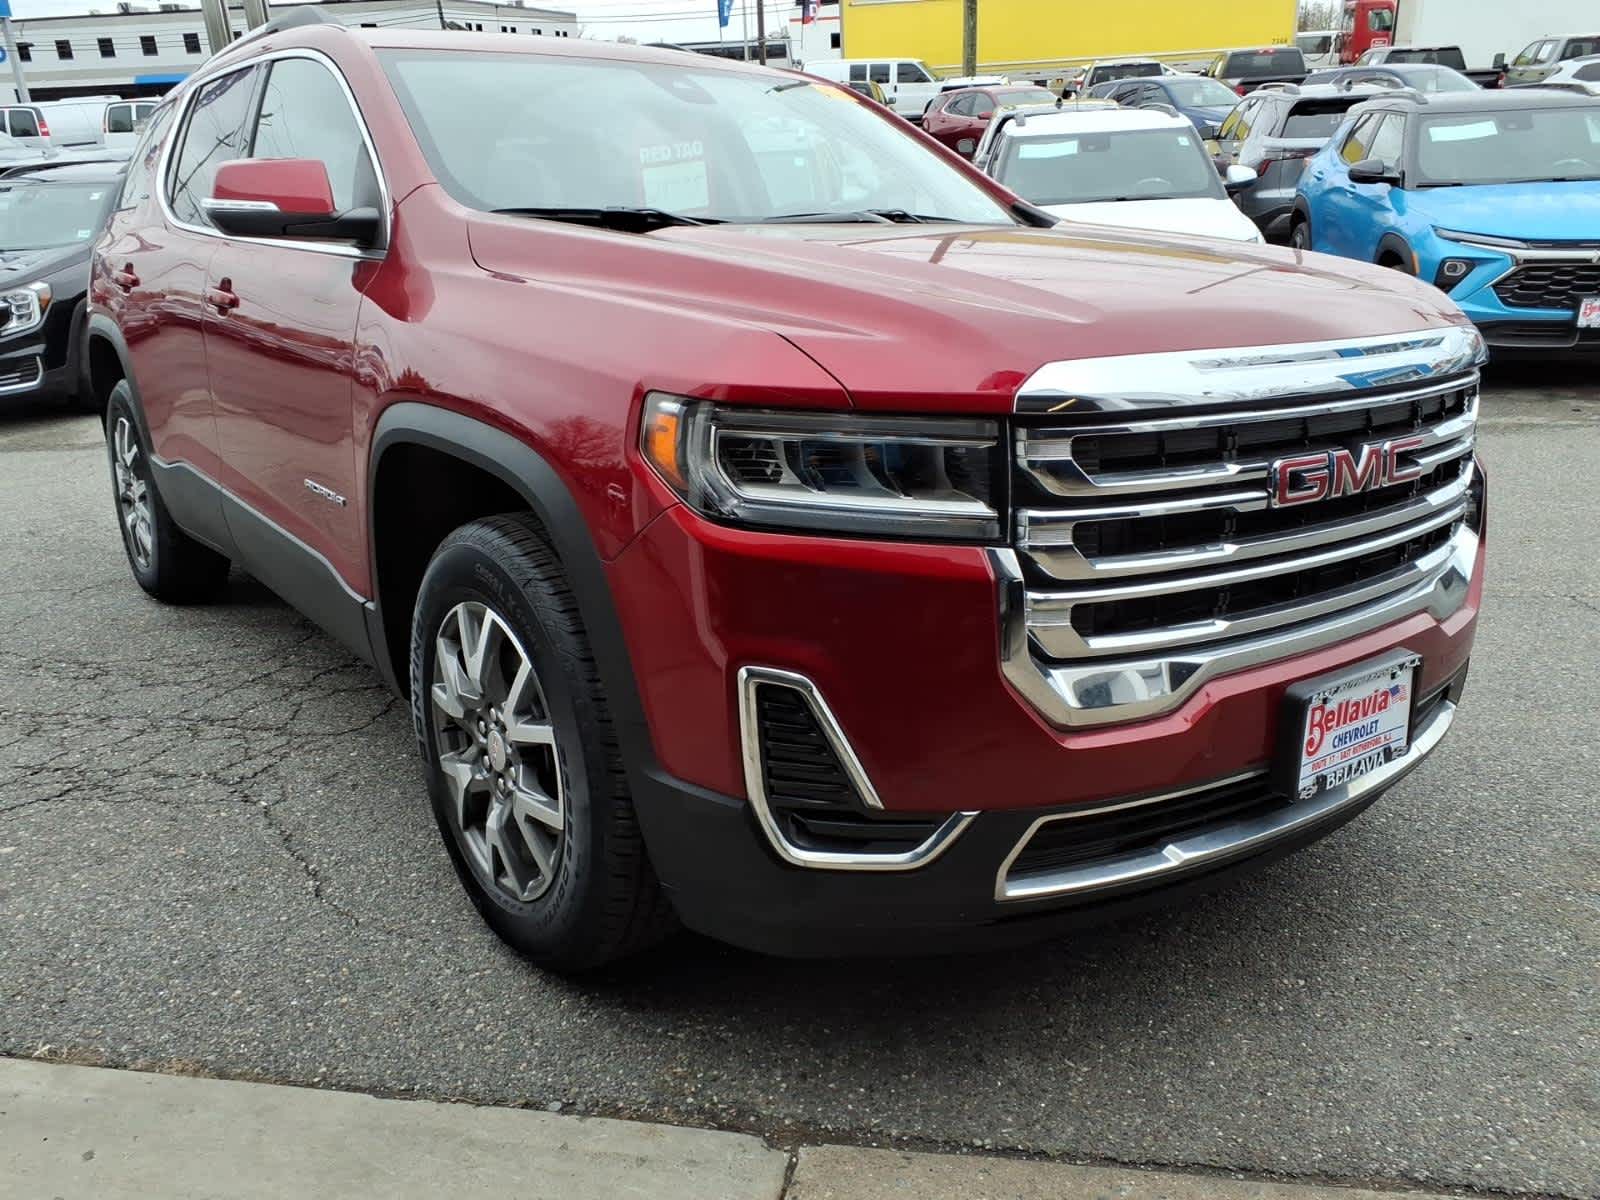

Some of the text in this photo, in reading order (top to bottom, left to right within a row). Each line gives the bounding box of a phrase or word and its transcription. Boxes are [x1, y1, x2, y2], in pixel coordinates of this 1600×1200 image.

[1272, 438, 1423, 508] GMC
[1305, 688, 1390, 757] Bellavia
[1332, 719, 1379, 748] CHEVROLET
[1326, 750, 1385, 790] BELLAVIA
